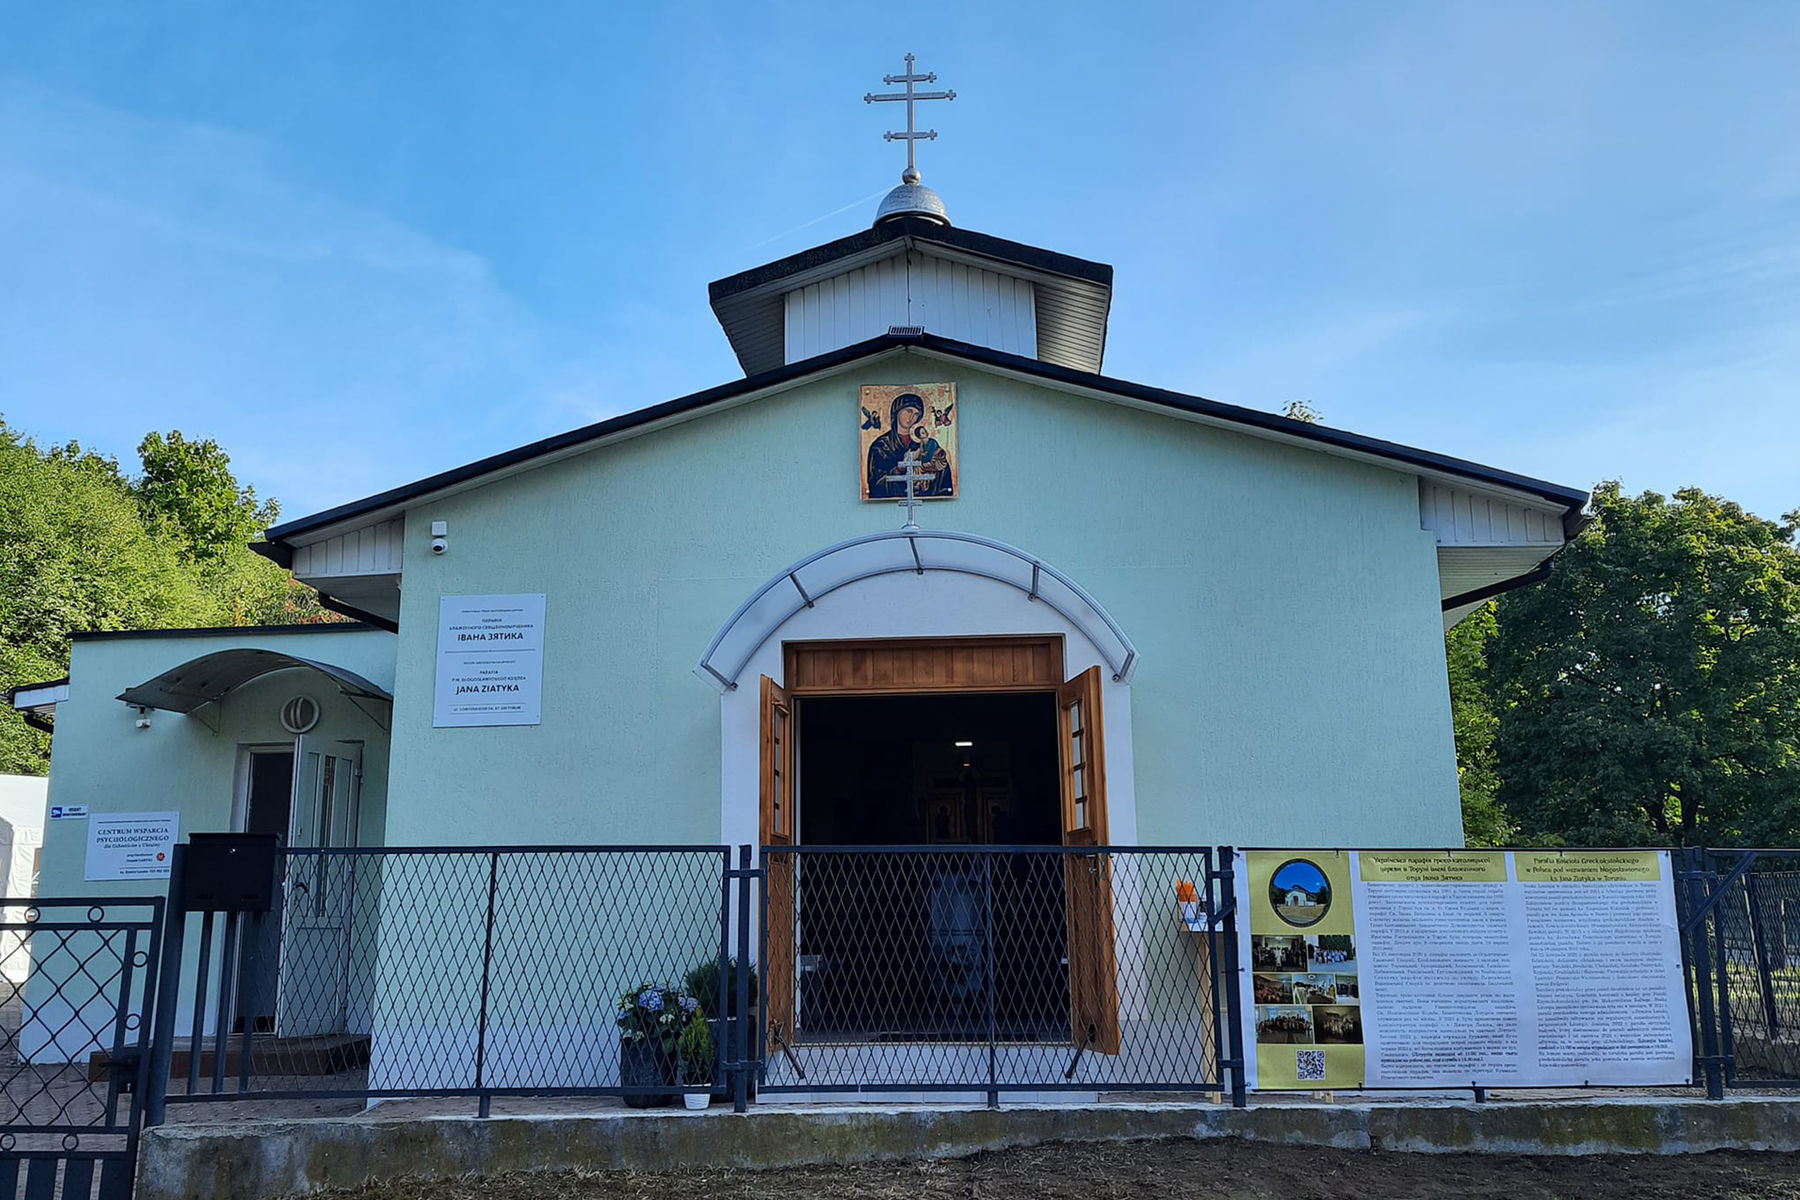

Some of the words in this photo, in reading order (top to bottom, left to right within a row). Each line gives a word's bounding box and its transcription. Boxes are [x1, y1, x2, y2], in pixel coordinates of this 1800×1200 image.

[457, 633, 486, 642] ІВАНА
[488, 632, 524, 641] ЗЯТИКА
[456, 685, 480, 695] JANA
[481, 684, 520, 693] ZIATYKA
[96, 835, 170, 843] PSYCHOLOGICZNEGO
